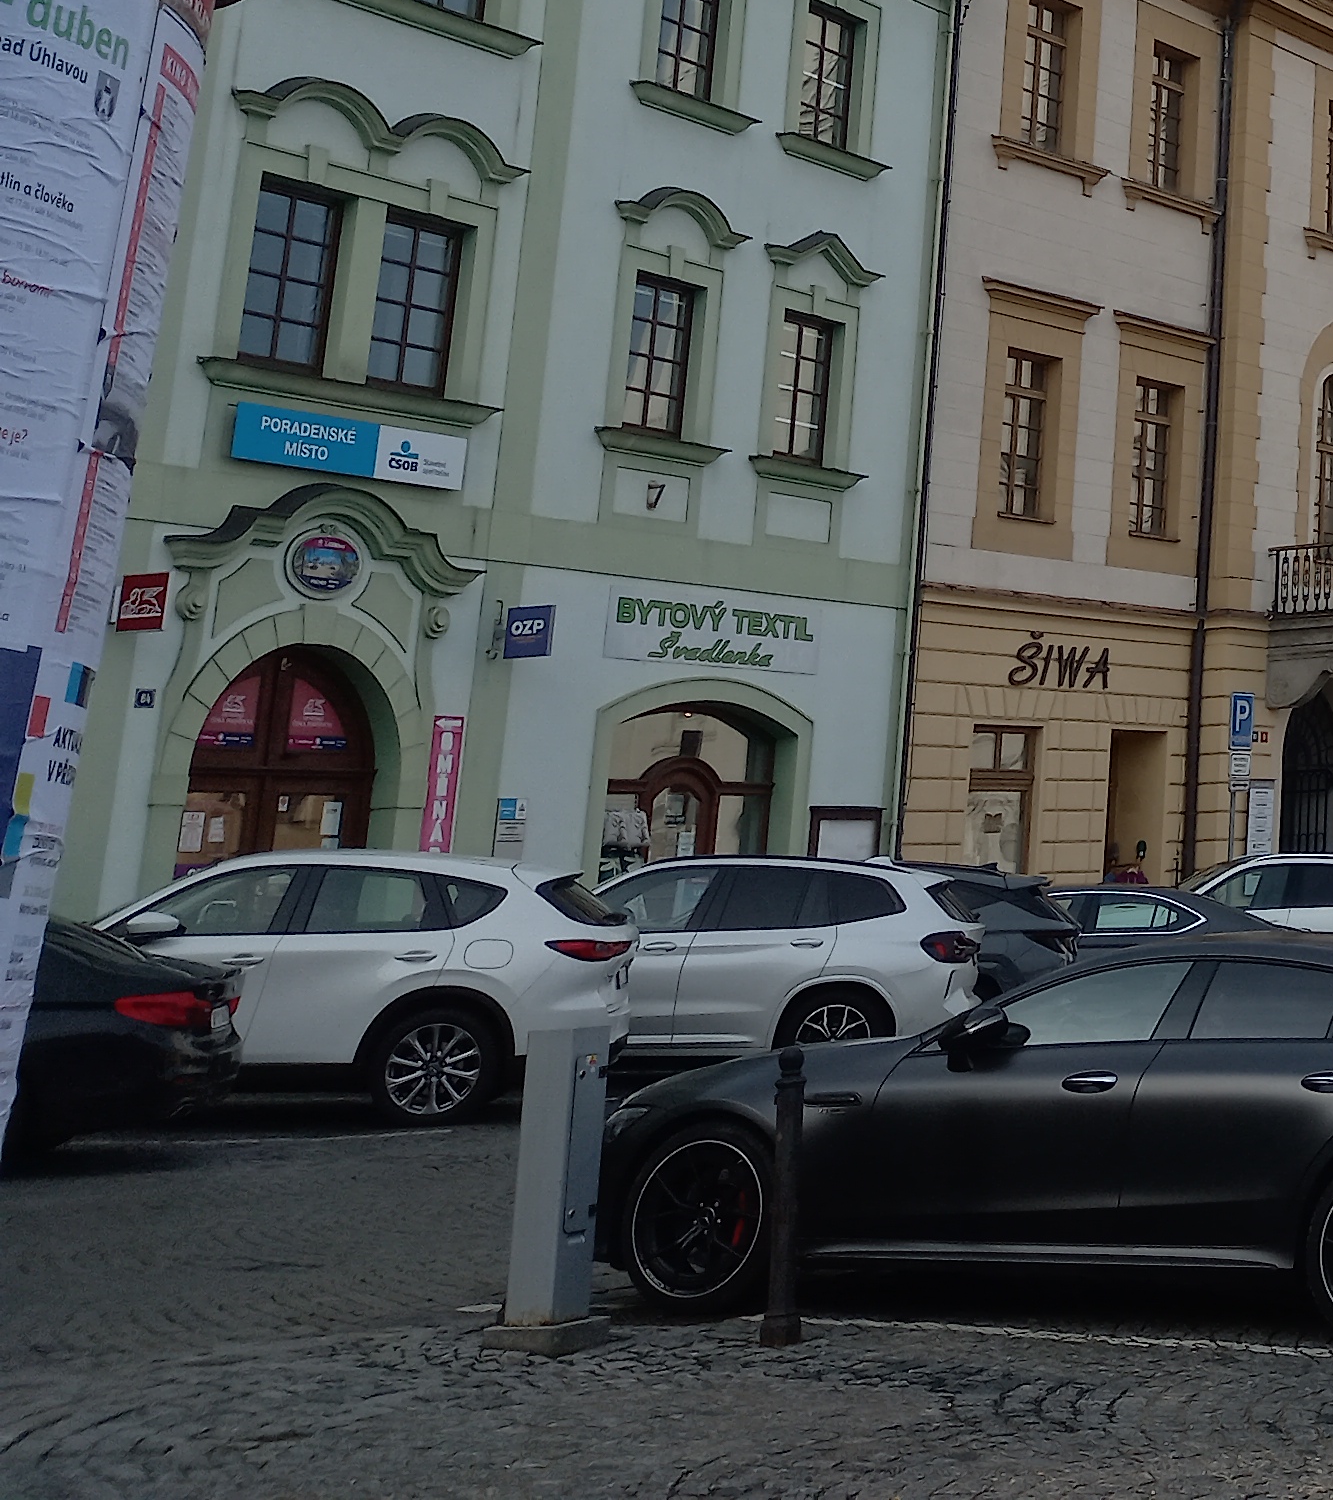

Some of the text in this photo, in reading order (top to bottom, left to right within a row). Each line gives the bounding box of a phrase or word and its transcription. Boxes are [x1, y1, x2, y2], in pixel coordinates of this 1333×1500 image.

[30, 41, 88, 84] Úhlavou
[24, 183, 32, 196] a
[35, 182, 74, 213] člověka
[9, 428, 27, 446] je?
[261, 415, 357, 445] PORADENSKÉ
[284, 439, 329, 461] MÍSTO
[388, 456, 418, 472] ČSOB
[646, 480, 666, 511] 7
[510, 618, 546, 637] OZP
[616, 597, 814, 642] BYTOVÝ TEXTIL
[647, 631, 774, 667] Švadlenka
[1008, 630, 1110, 690] ŠIWA
[1235, 700, 1250, 732] P
